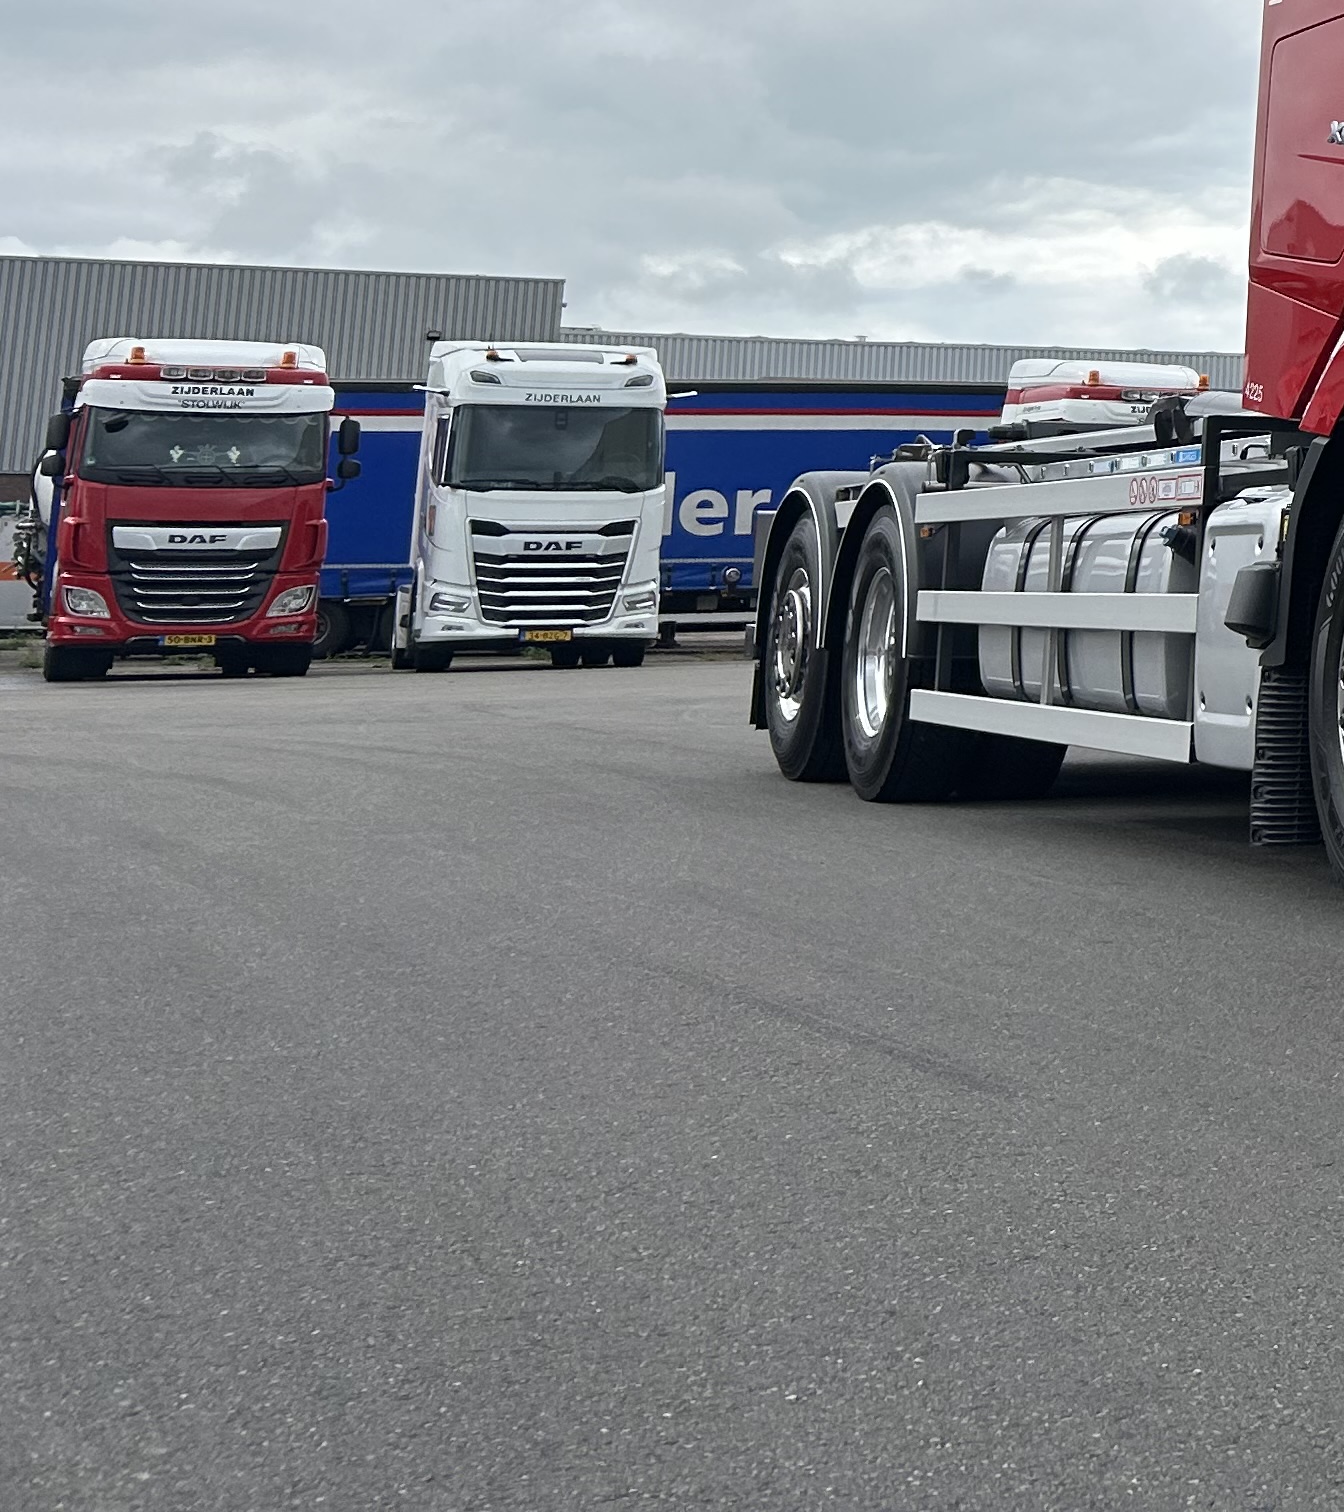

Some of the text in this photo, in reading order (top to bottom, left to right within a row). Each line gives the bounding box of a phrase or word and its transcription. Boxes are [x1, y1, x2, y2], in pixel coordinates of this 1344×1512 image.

[171, 386, 255, 397] ZIJDERLAAN
[524, 393, 601, 403] ZIJDERLAAN
[167, 534, 228, 544] DAF
[523, 541, 583, 551] DAF
